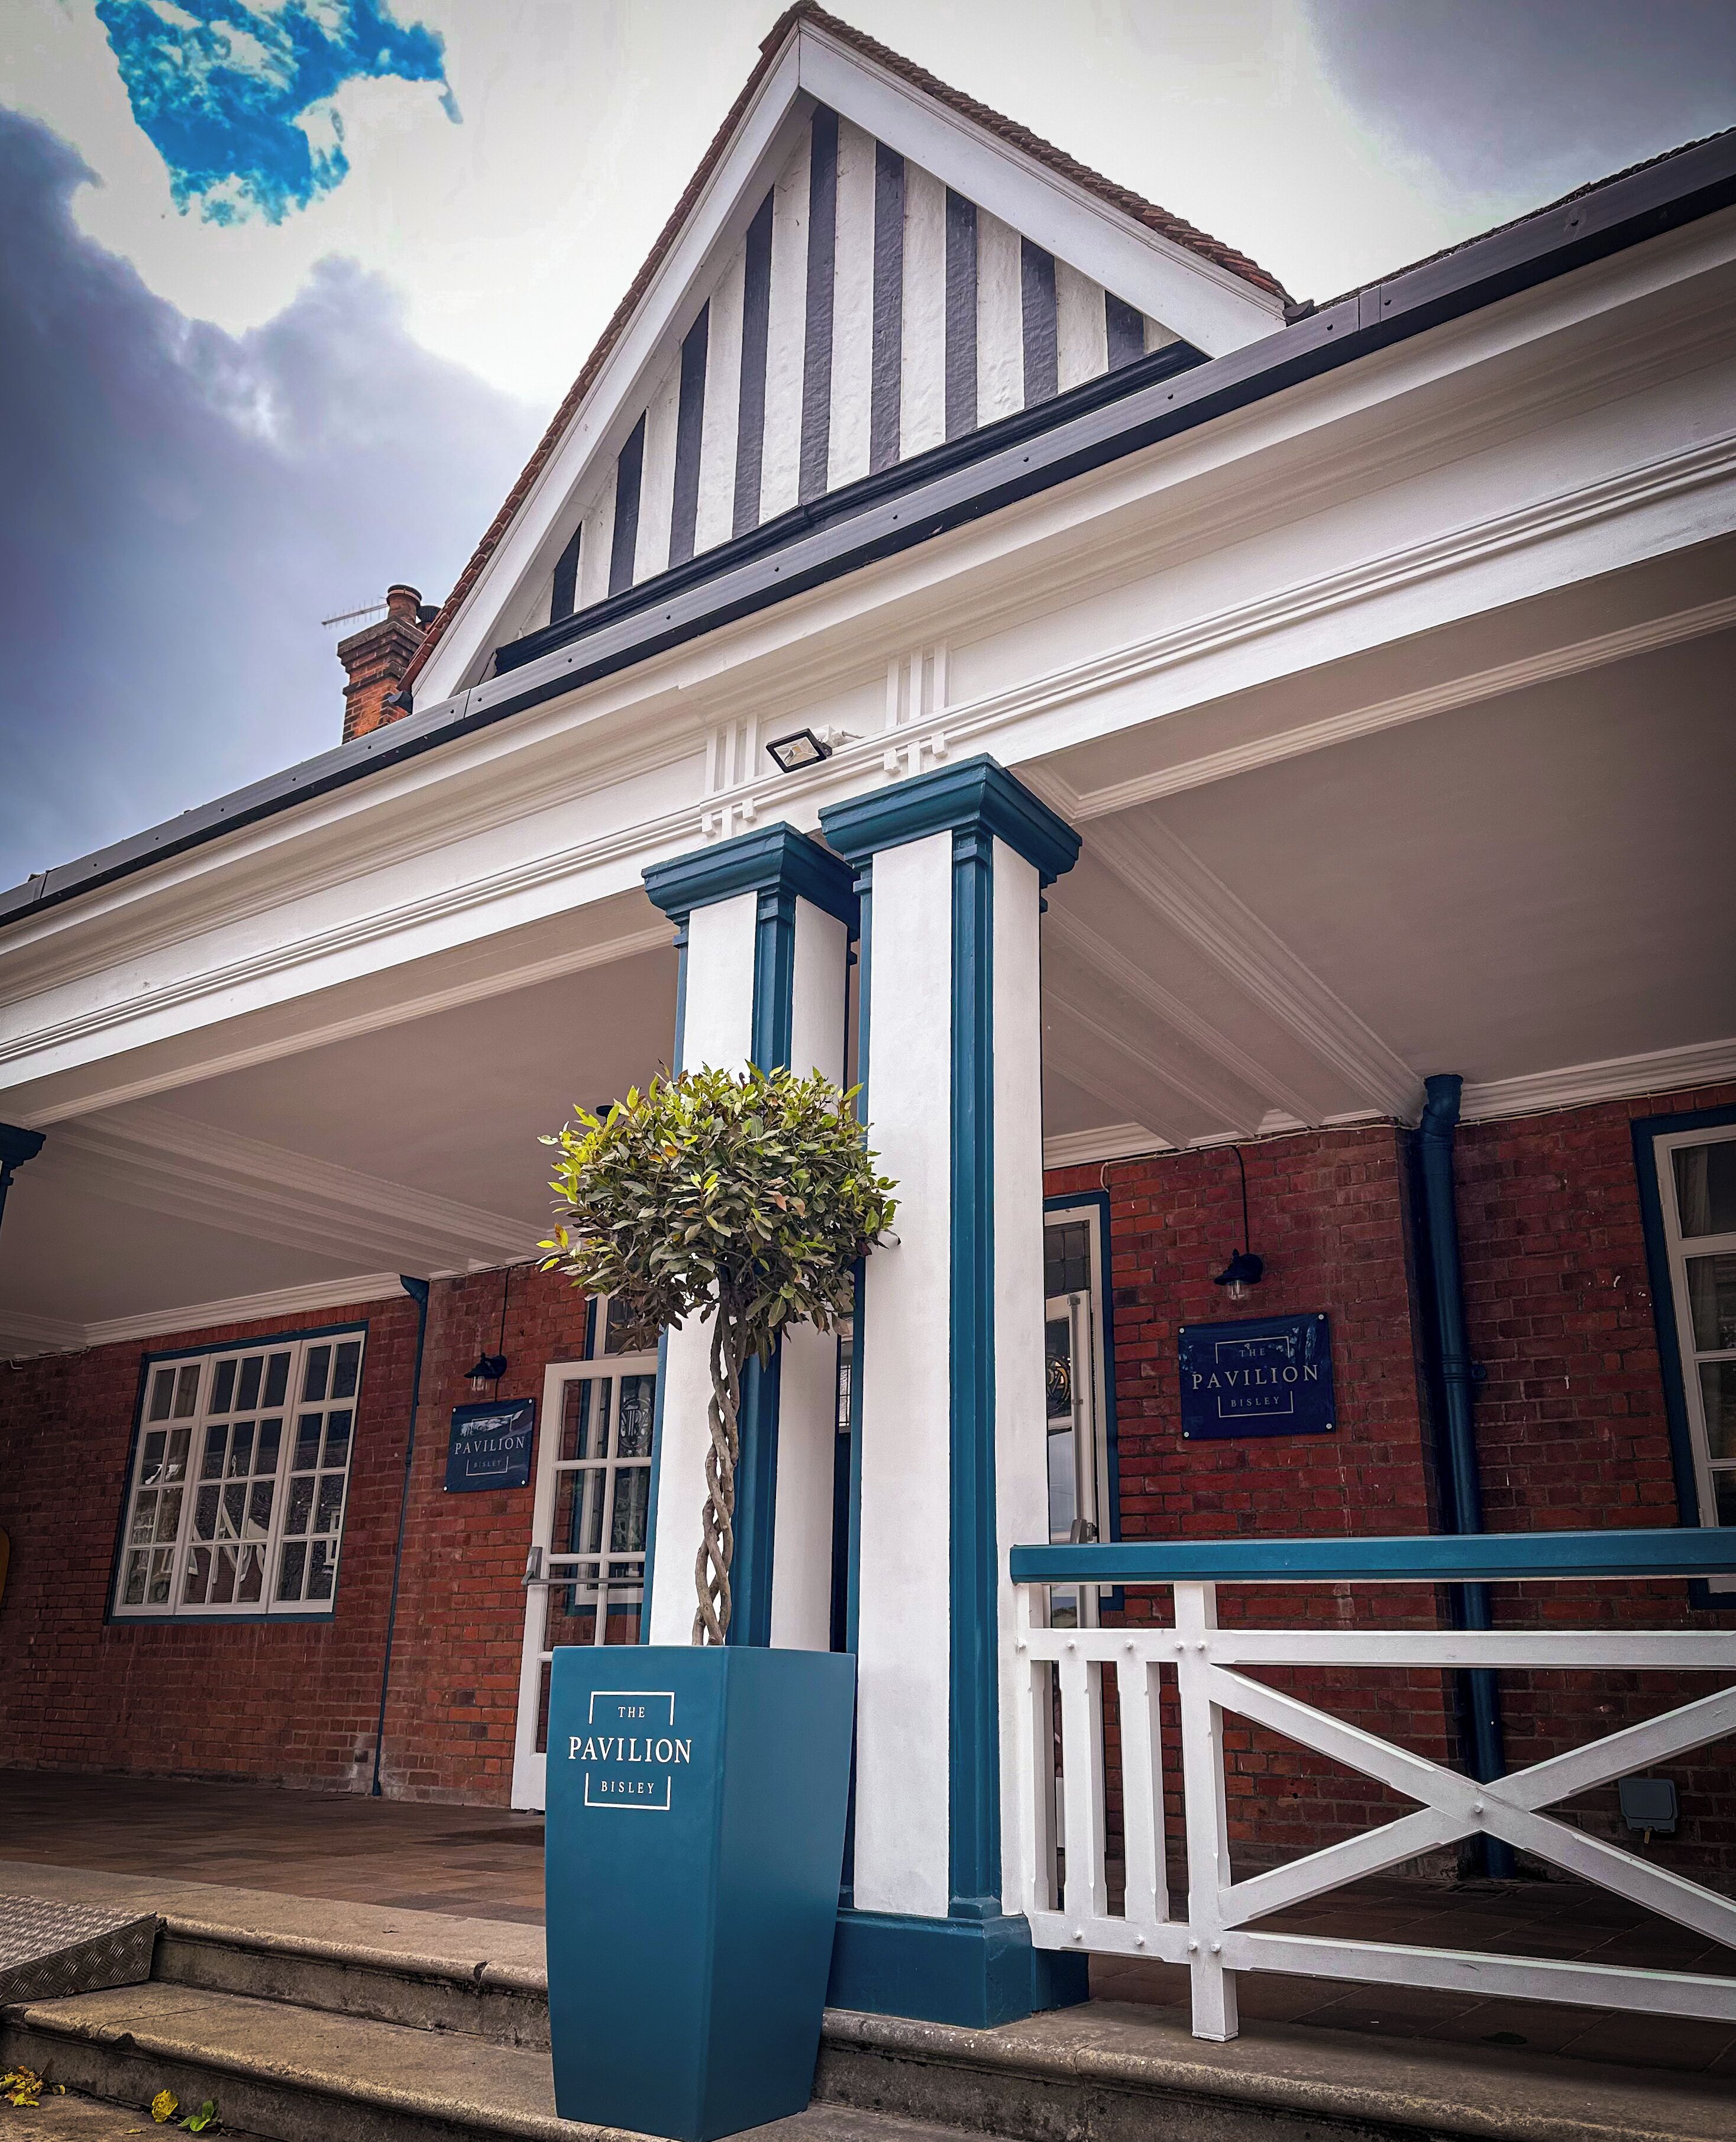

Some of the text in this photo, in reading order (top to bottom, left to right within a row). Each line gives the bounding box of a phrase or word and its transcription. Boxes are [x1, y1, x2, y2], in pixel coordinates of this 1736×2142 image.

[1239, 1348, 1266, 1358] THE
[1192, 1364, 1318, 1390] PAVILION
[1230, 1396, 1281, 1407] BISLEY
[454, 1436, 525, 1455] PAVILION
[618, 1706, 645, 1718] THE
[568, 1736, 692, 1764] PAVILION
[600, 1781, 655, 1794] BISLEY
